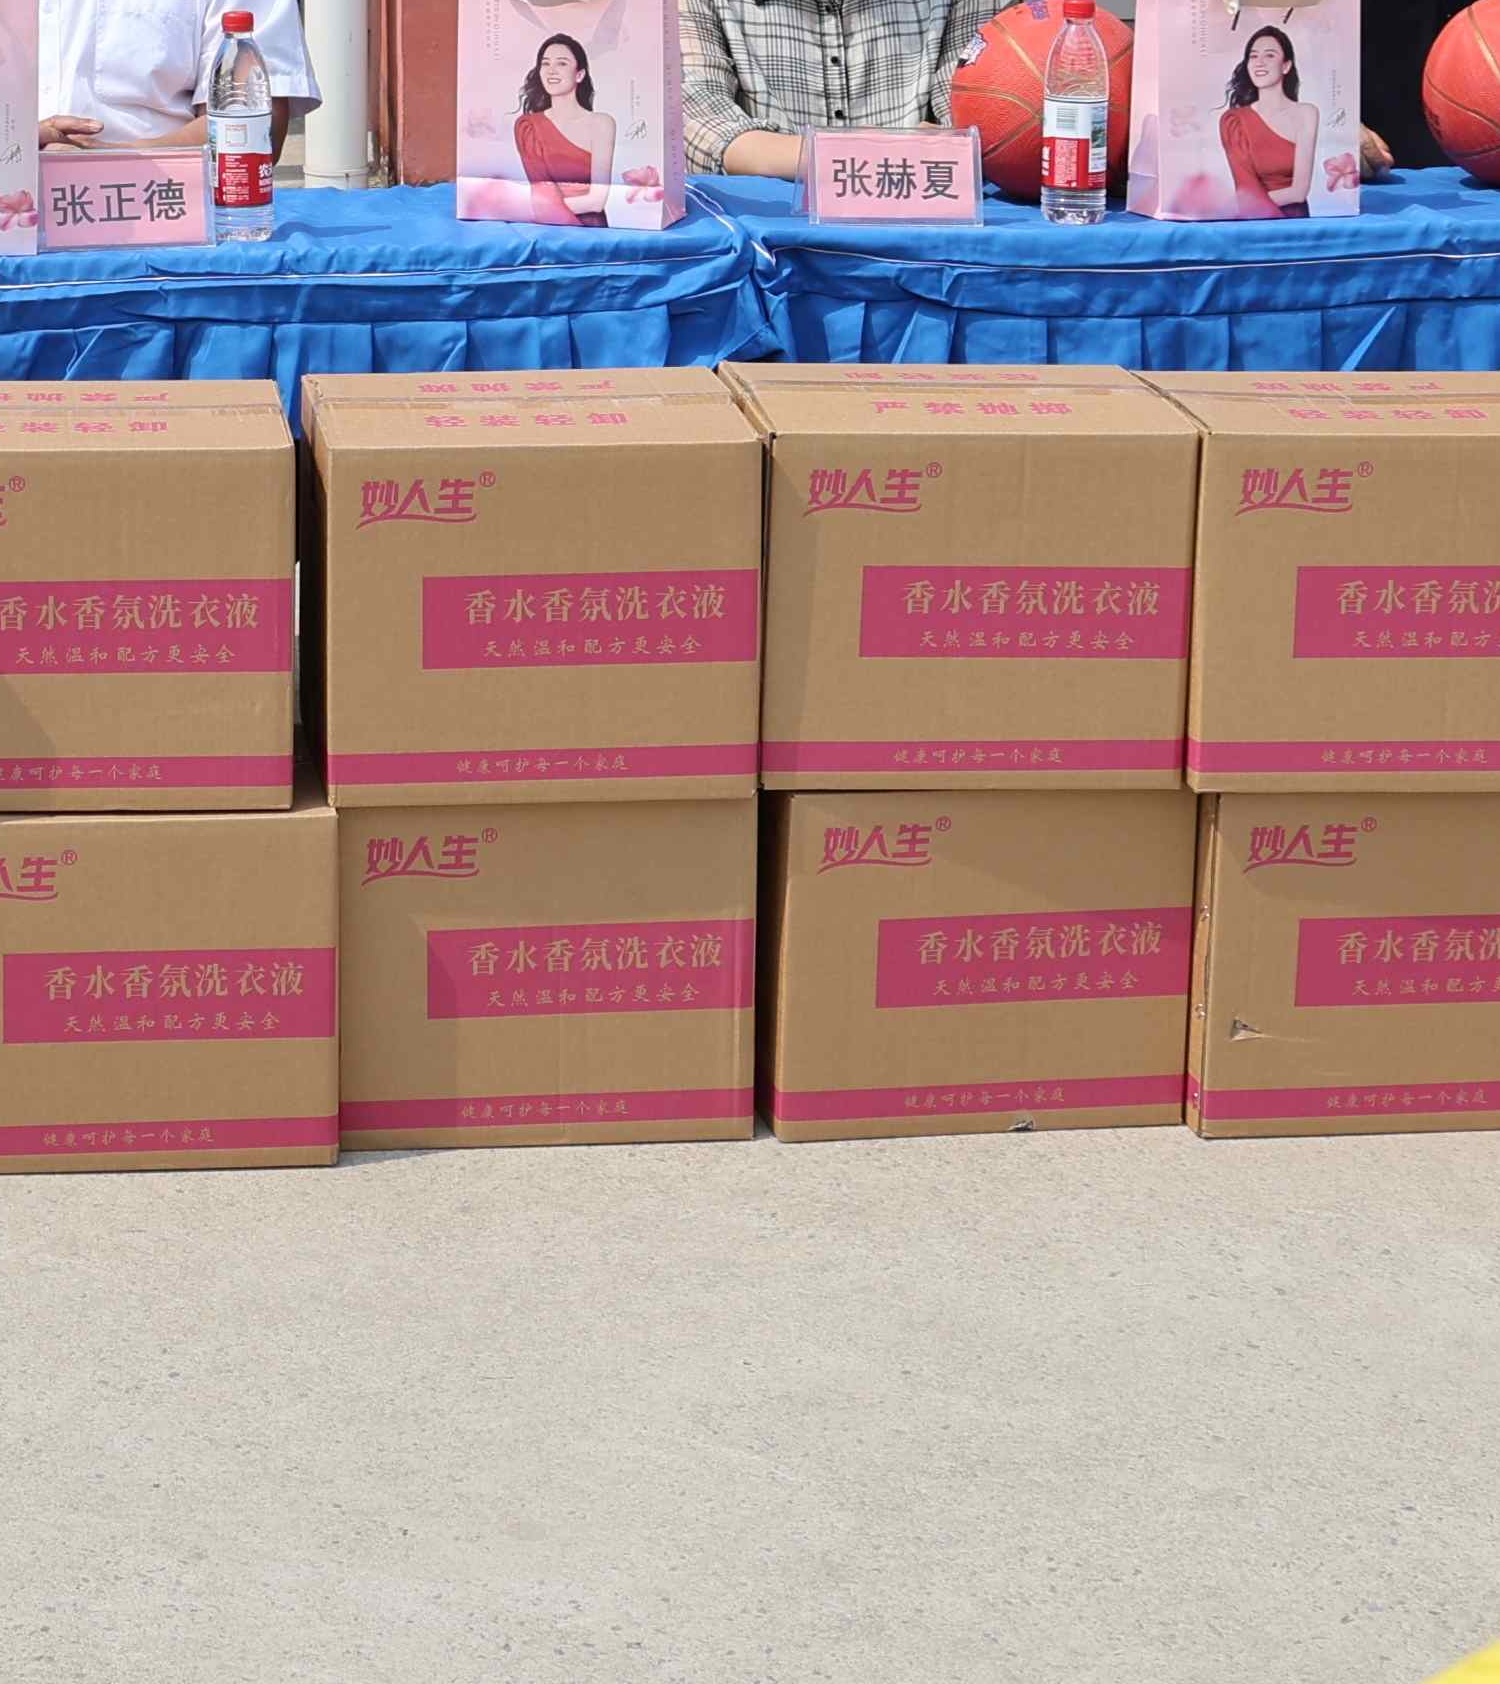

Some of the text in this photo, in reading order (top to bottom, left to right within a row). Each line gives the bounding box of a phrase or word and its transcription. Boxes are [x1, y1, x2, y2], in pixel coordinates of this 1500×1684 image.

[833, 158, 958, 199] 张赫夏
[51, 179, 185, 226] 张正德
[467, 587, 725, 622] 香水香氛洗衣液
[903, 579, 1159, 616] 香水香氛洗衣液
[16, 643, 234, 666] 天然温和配方更安全
[486, 635, 698, 656] 天然温和配方更安全
[920, 631, 1130, 652] 天然温和配方更安全
[470, 936, 723, 973] 香水香氛洗衣液
[918, 923, 1163, 965] 香水香氛洗衣液
[46, 963, 305, 998] 香水香氛洗衣液
[489, 987, 697, 1006] 天然温和配方更安全
[931, 970, 1141, 999] 天然温和配方更安全
[64, 1012, 281, 1035] 天然温和配方更安全
